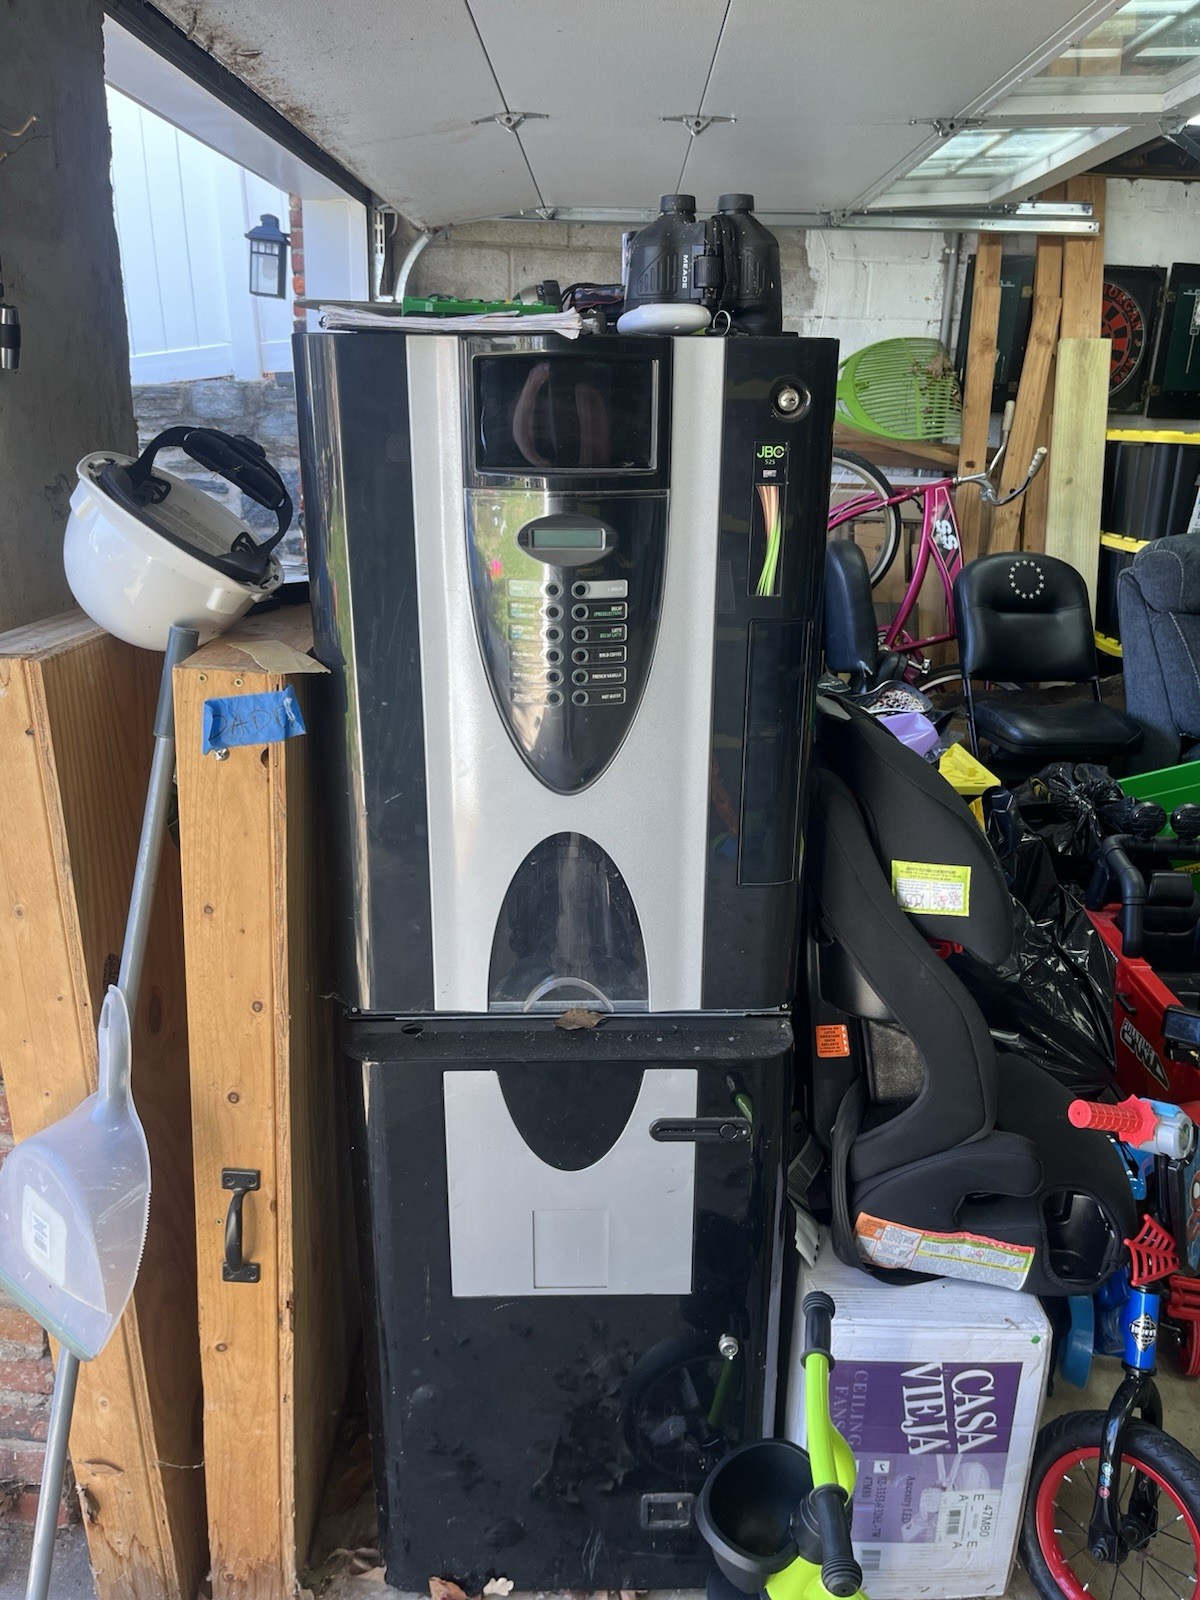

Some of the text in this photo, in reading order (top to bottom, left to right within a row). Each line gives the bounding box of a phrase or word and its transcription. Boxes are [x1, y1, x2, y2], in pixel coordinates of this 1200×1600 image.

[756, 445, 785, 458] JBC
[833, 1385, 849, 1430] FANS
[850, 1370, 869, 1447] CEILING
[900, 1361, 950, 1456] VIEJA
[952, 1369, 998, 1454] CASA
[901, 1475, 916, 1507] Ancestry
[958, 1493, 969, 1502] A
[973, 1493, 985, 1501] E
[980, 1504, 993, 1537] 47M80
[952, 1541, 963, 1549] A
[966, 1540, 978, 1548] E
